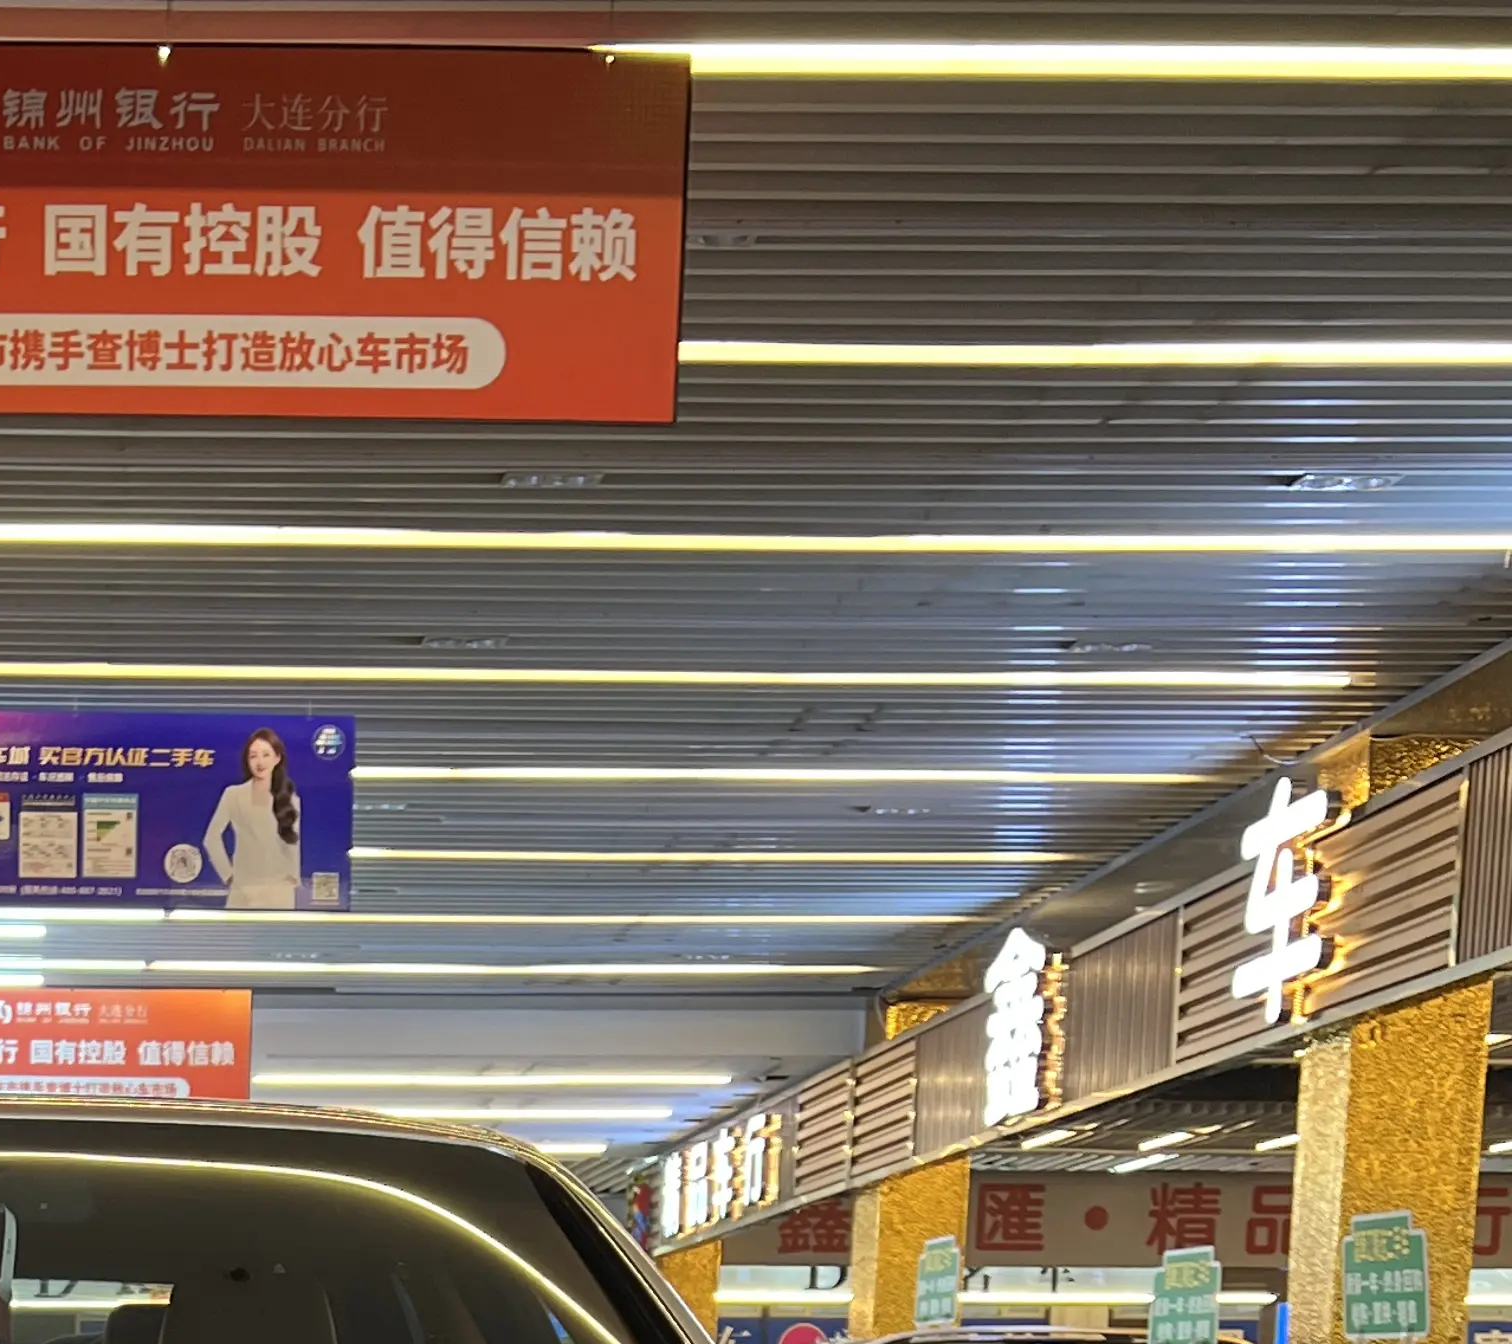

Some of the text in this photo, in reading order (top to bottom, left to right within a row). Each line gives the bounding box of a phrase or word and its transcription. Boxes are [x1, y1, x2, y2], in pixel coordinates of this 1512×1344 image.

[2, 87, 389, 133] 锦州银行 大连分行
[2, 135, 386, 153] BANK OF JINZHOU DALIAN BRANCH
[42, 203, 322, 280] 国有控股
[356, 205, 637, 283] 值得信赖
[30, 1039, 127, 1066] 国有控股
[138, 1040, 235, 1067] 值得信赖
